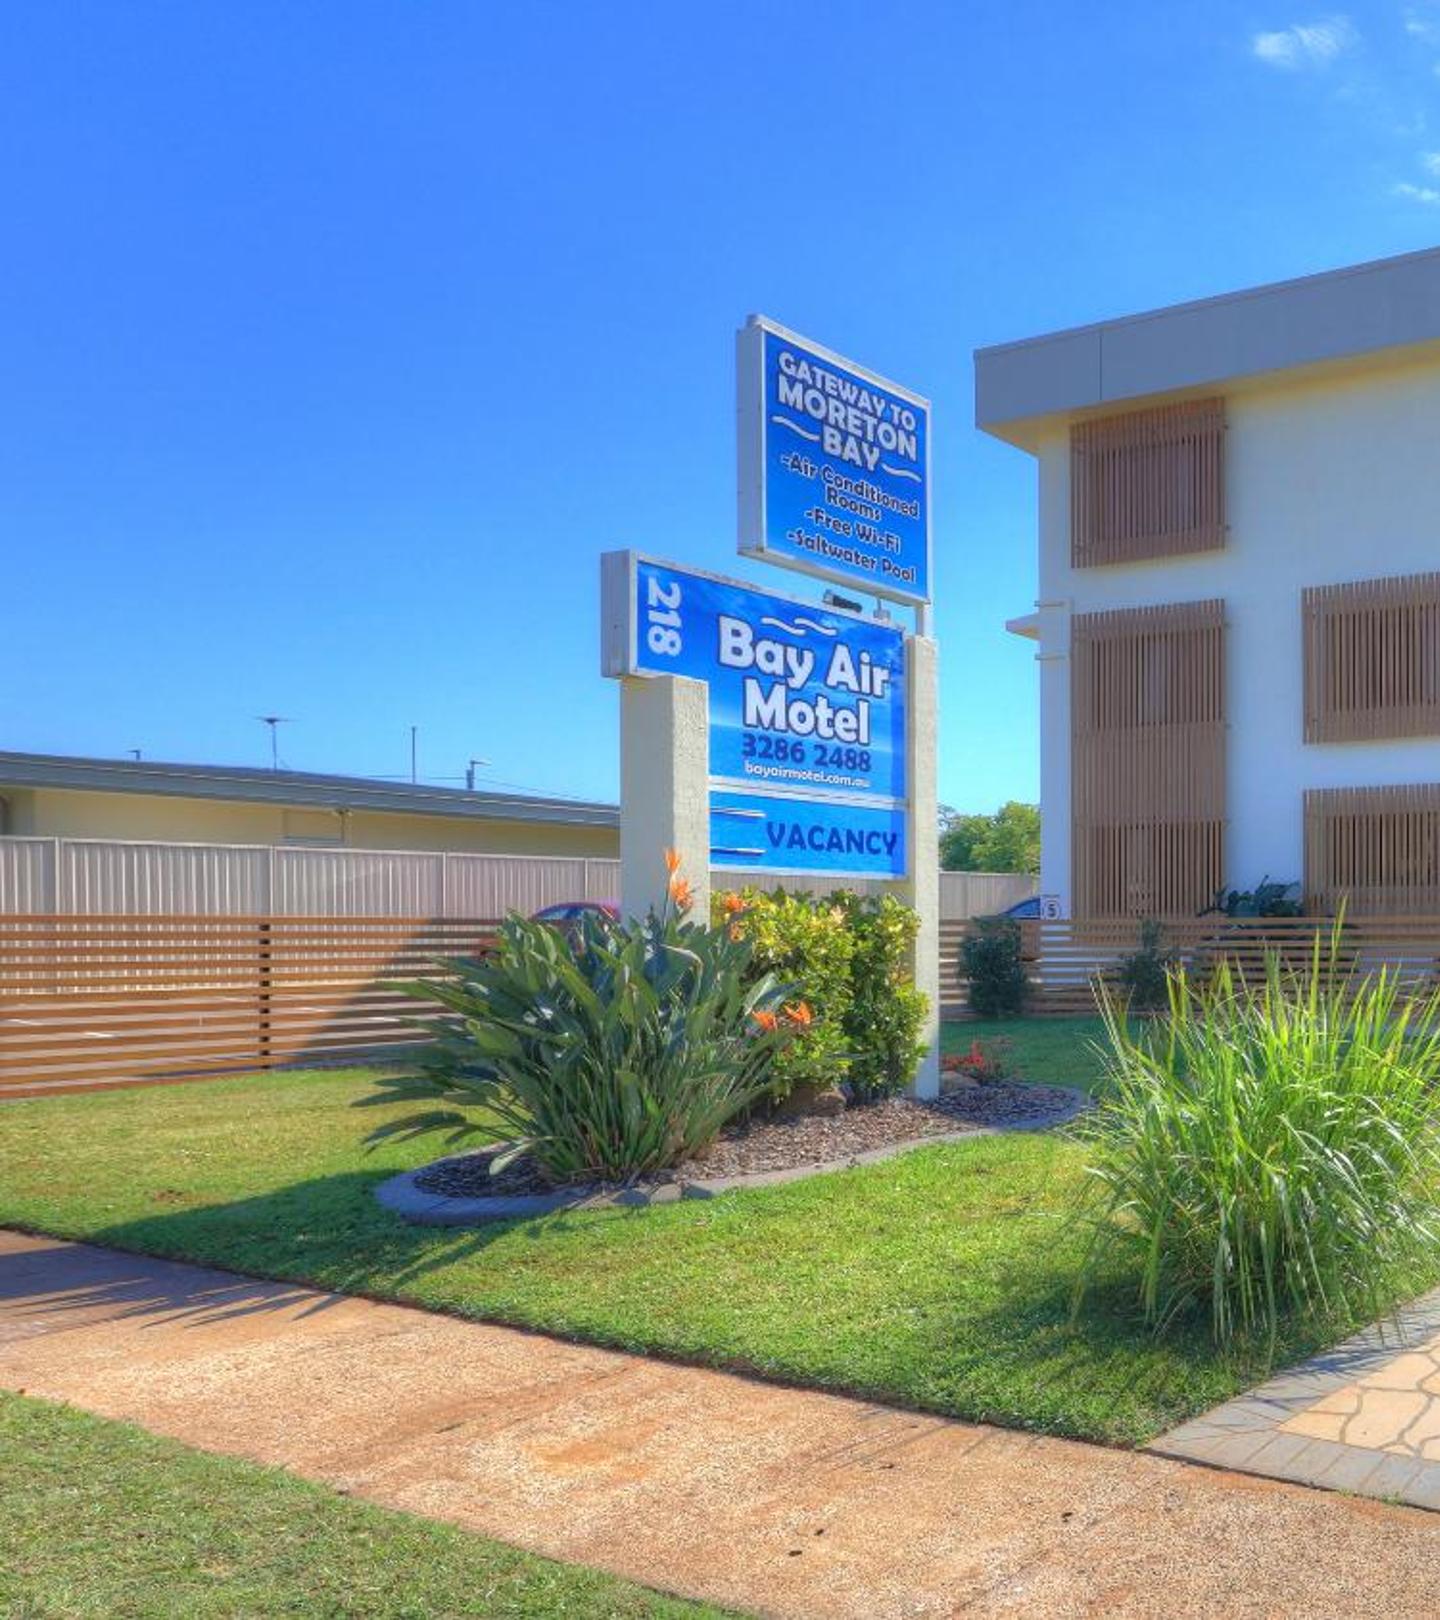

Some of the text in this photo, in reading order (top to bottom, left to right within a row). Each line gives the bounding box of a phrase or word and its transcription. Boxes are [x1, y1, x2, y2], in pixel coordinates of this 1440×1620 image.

[778, 352, 916, 430] GATEWAY TO
[777, 374, 917, 462] MORETON
[822, 424, 880, 472] BAY
[821, 464, 920, 519] Conditioned
[825, 484, 882, 521] Rooms
[854, 521, 901, 554] Wi-Fi
[880, 558, 917, 583] Pool
[647, 577, 682, 657] 218
[717, 614, 891, 698] Bay Air
[742, 677, 871, 746] Motel
[741, 733, 872, 772] 3286 2488
[743, 760, 872, 788] bayairmotel.com.au
[766, 821, 898, 855] VACANCY
